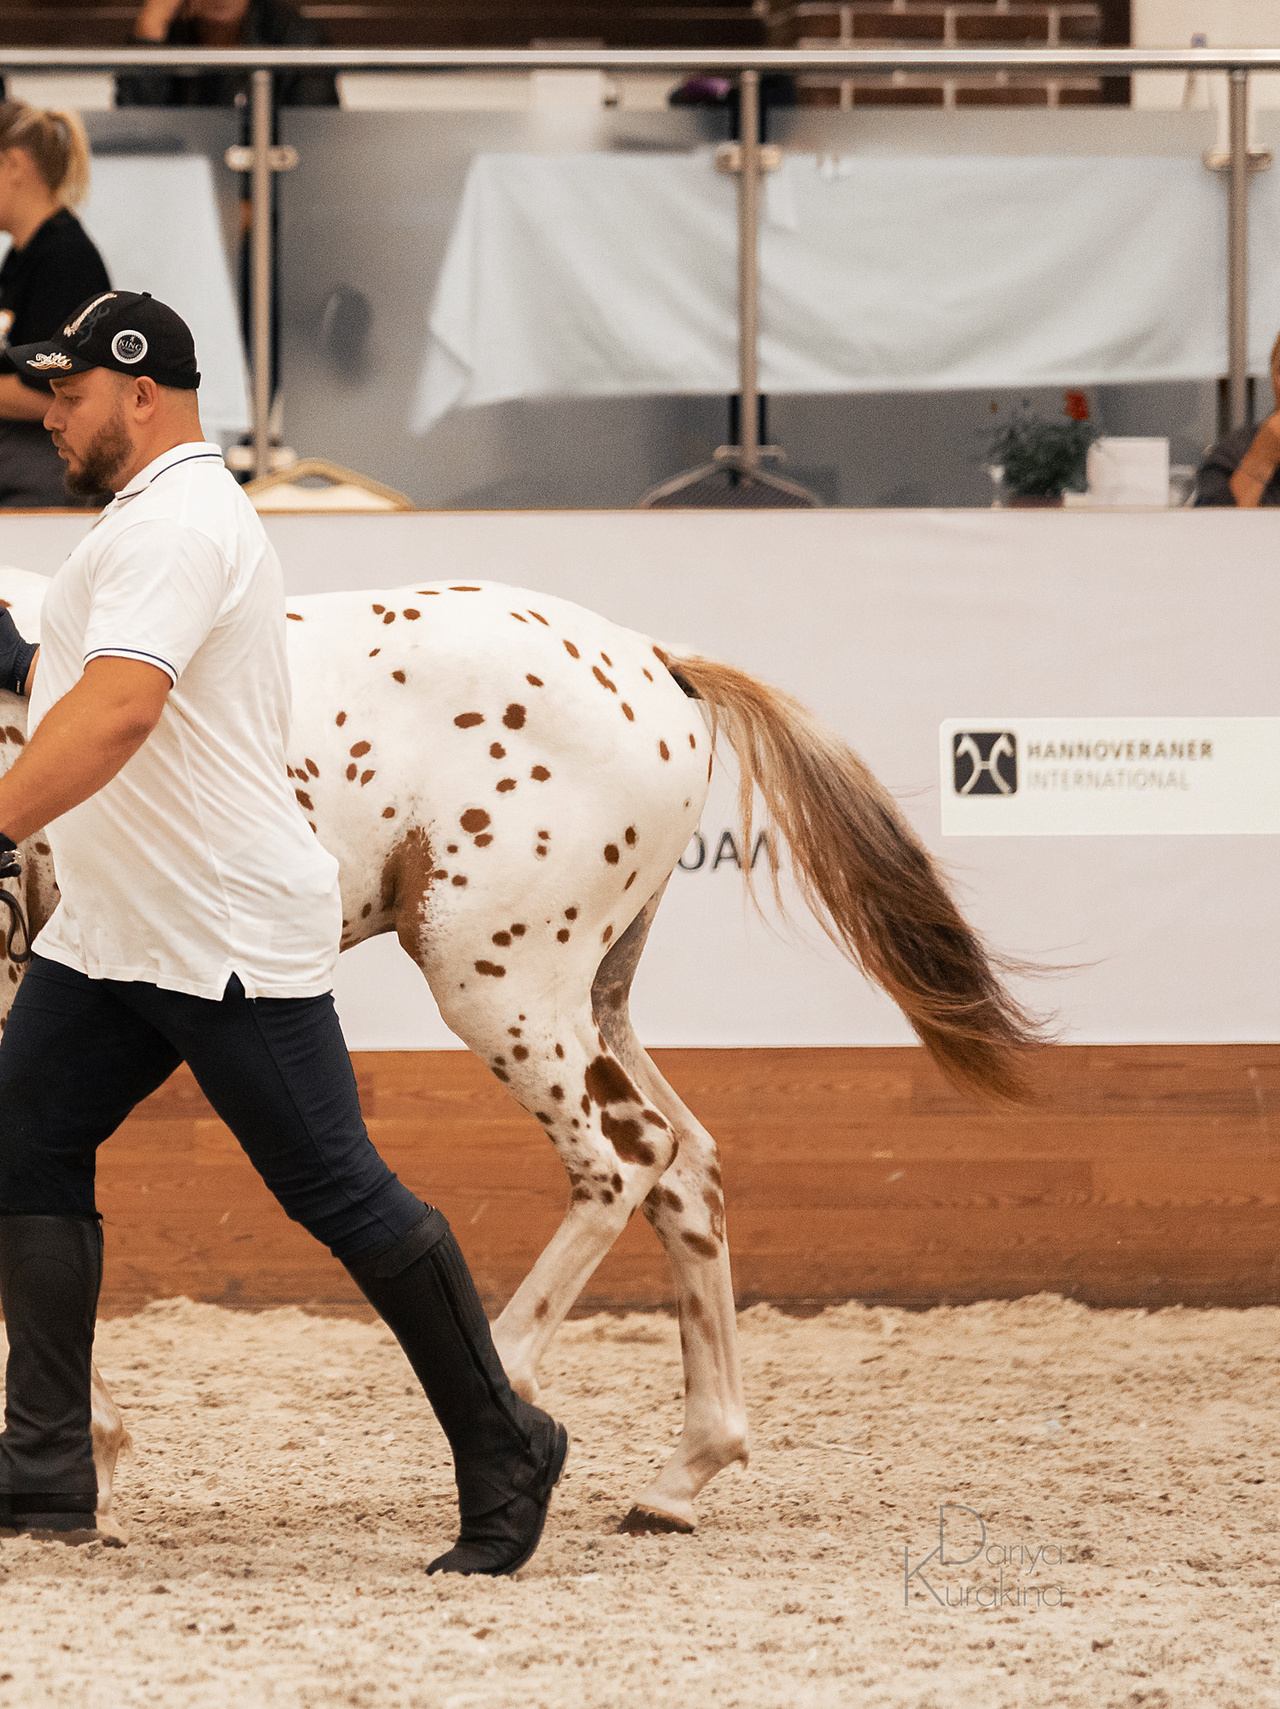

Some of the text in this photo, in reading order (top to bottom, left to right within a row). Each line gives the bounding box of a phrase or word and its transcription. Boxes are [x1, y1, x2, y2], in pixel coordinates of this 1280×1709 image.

[118, 338, 142, 351] KING
[1027, 739, 1214, 761] HANNOVERANER
[1027, 769, 1189, 791] INTERNATIONAL
